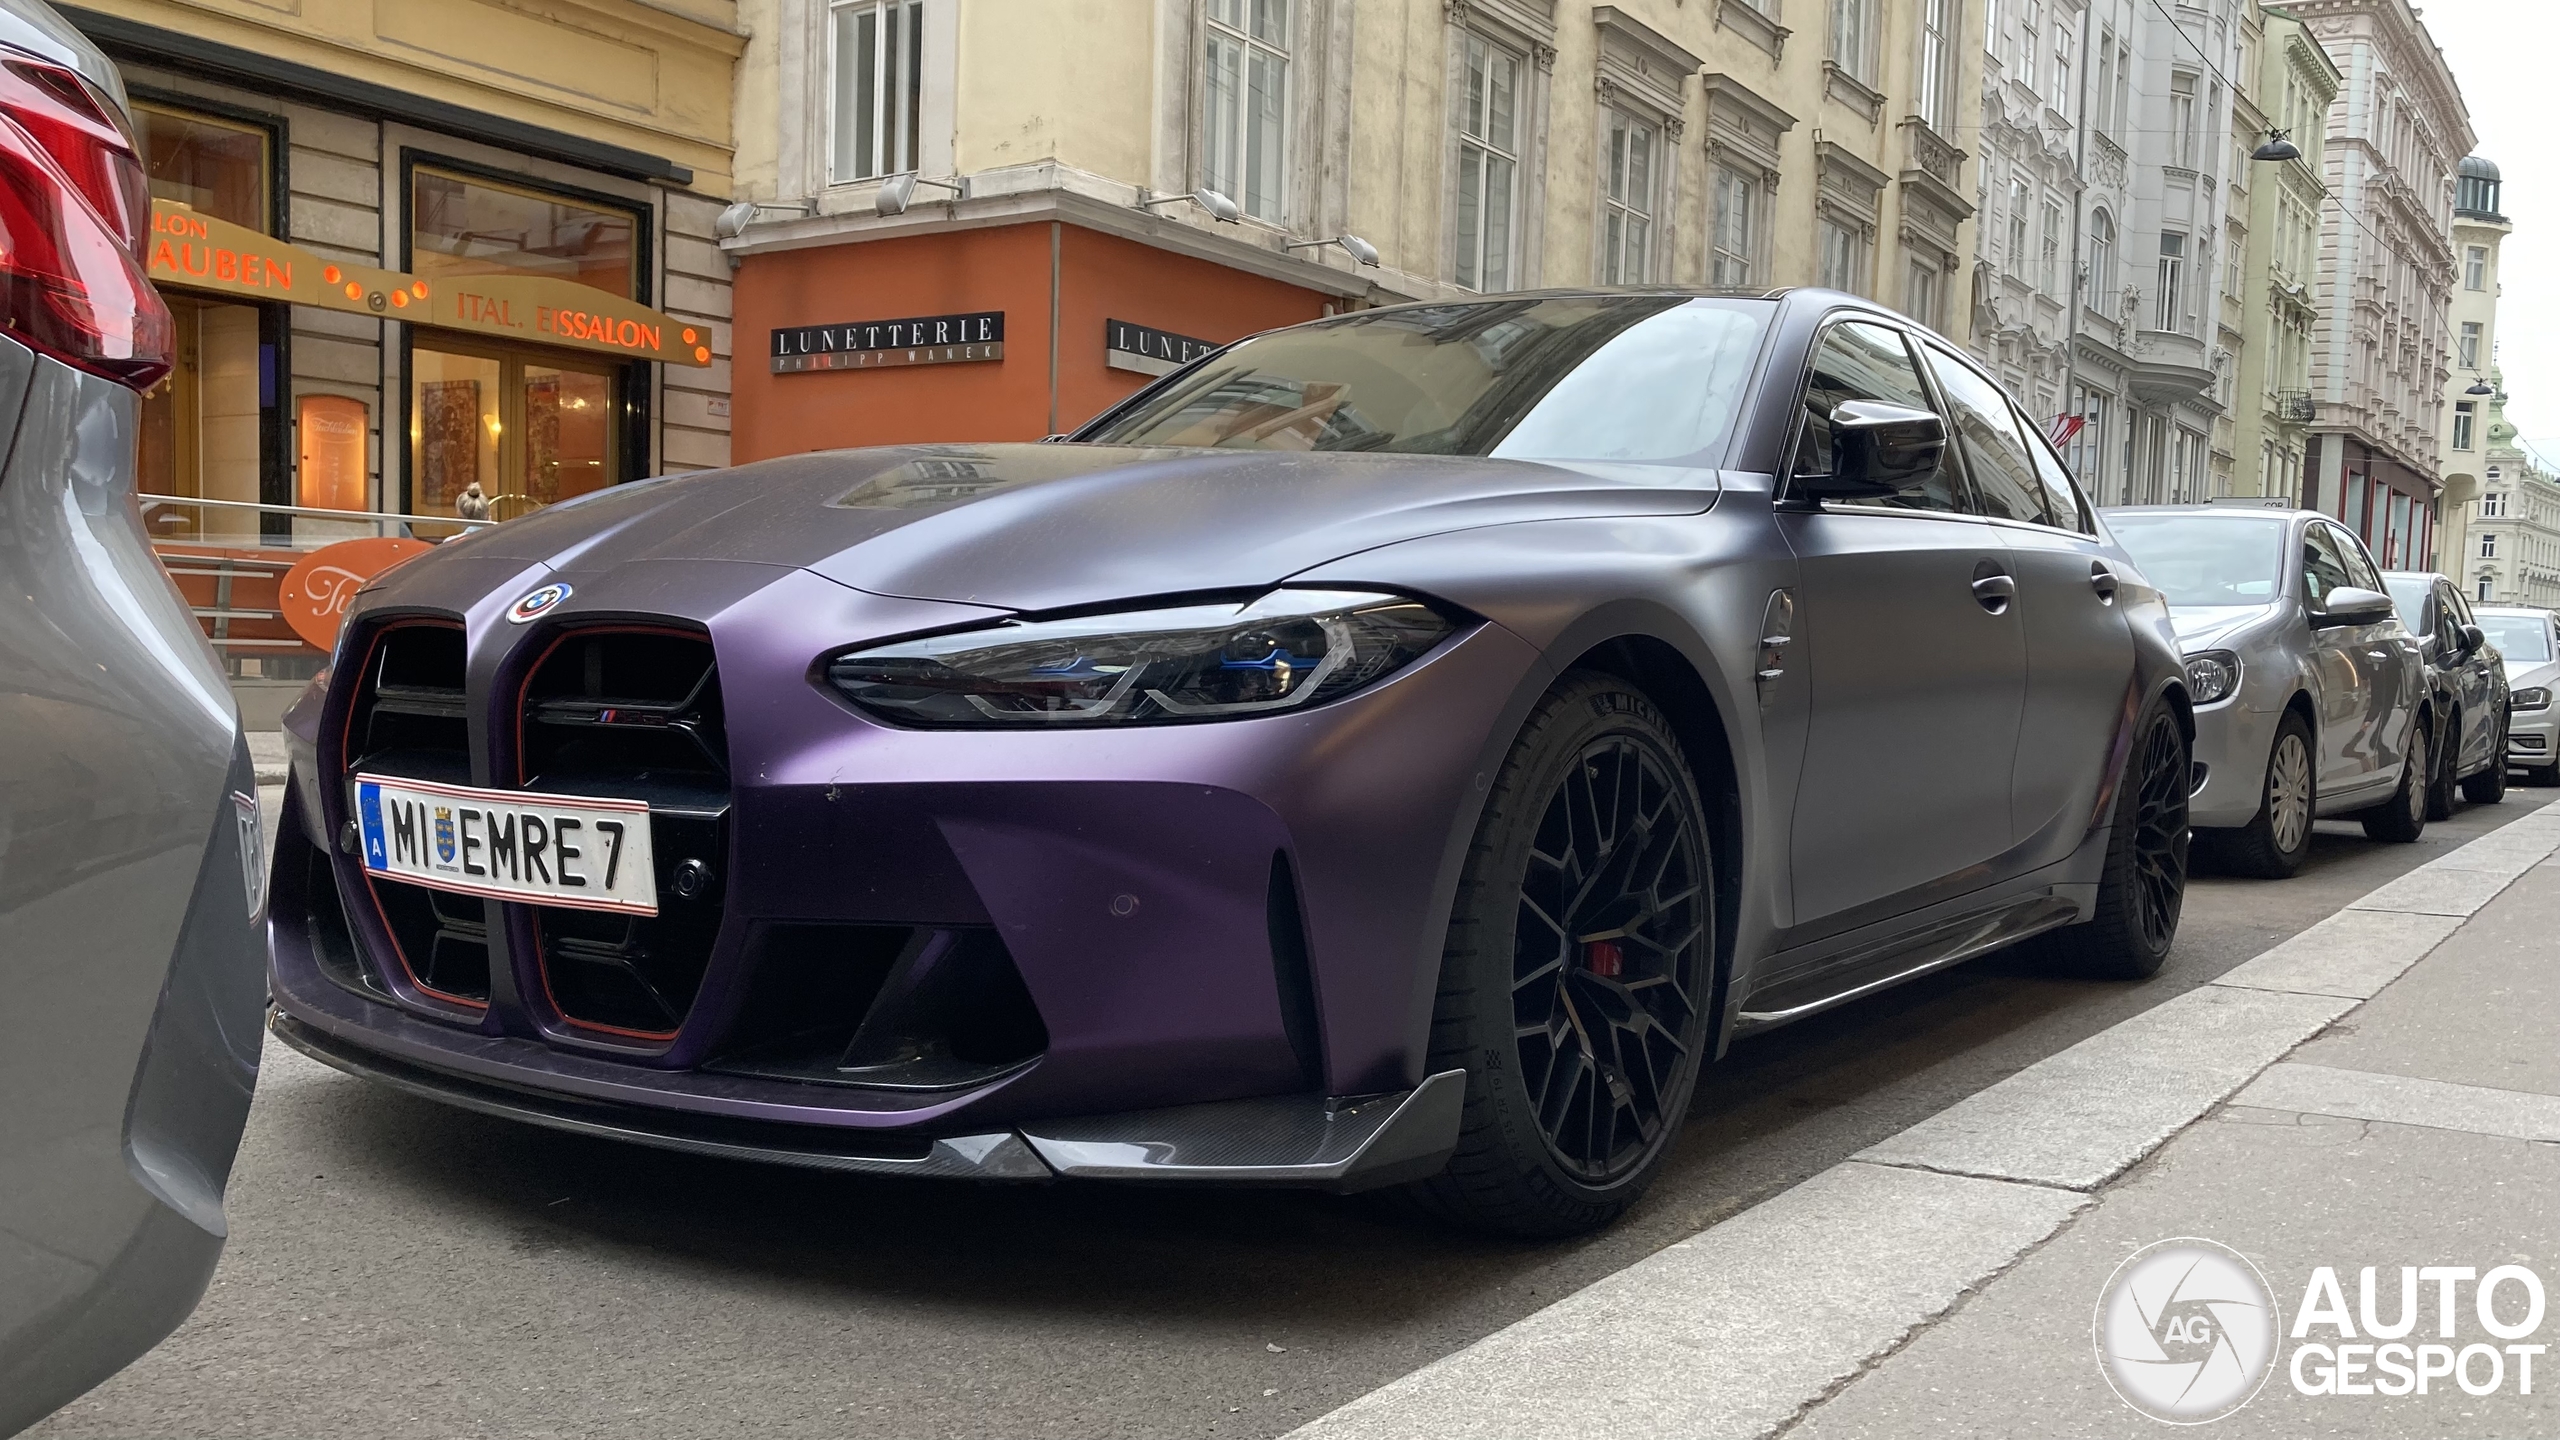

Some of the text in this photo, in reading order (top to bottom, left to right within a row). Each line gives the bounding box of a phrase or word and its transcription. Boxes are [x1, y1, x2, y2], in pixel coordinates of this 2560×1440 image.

[150, 211, 207, 240] LON
[152, 239, 292, 291] AUBEN
[457, 292, 661, 351] ITAL. EISSALON
[778, 317, 993, 355] LUNETTERIE
[779, 345, 991, 370] PHILIPP WANEK
[372, 837, 382, 857] A
[390, 798, 625, 890] MI EMRE 7
